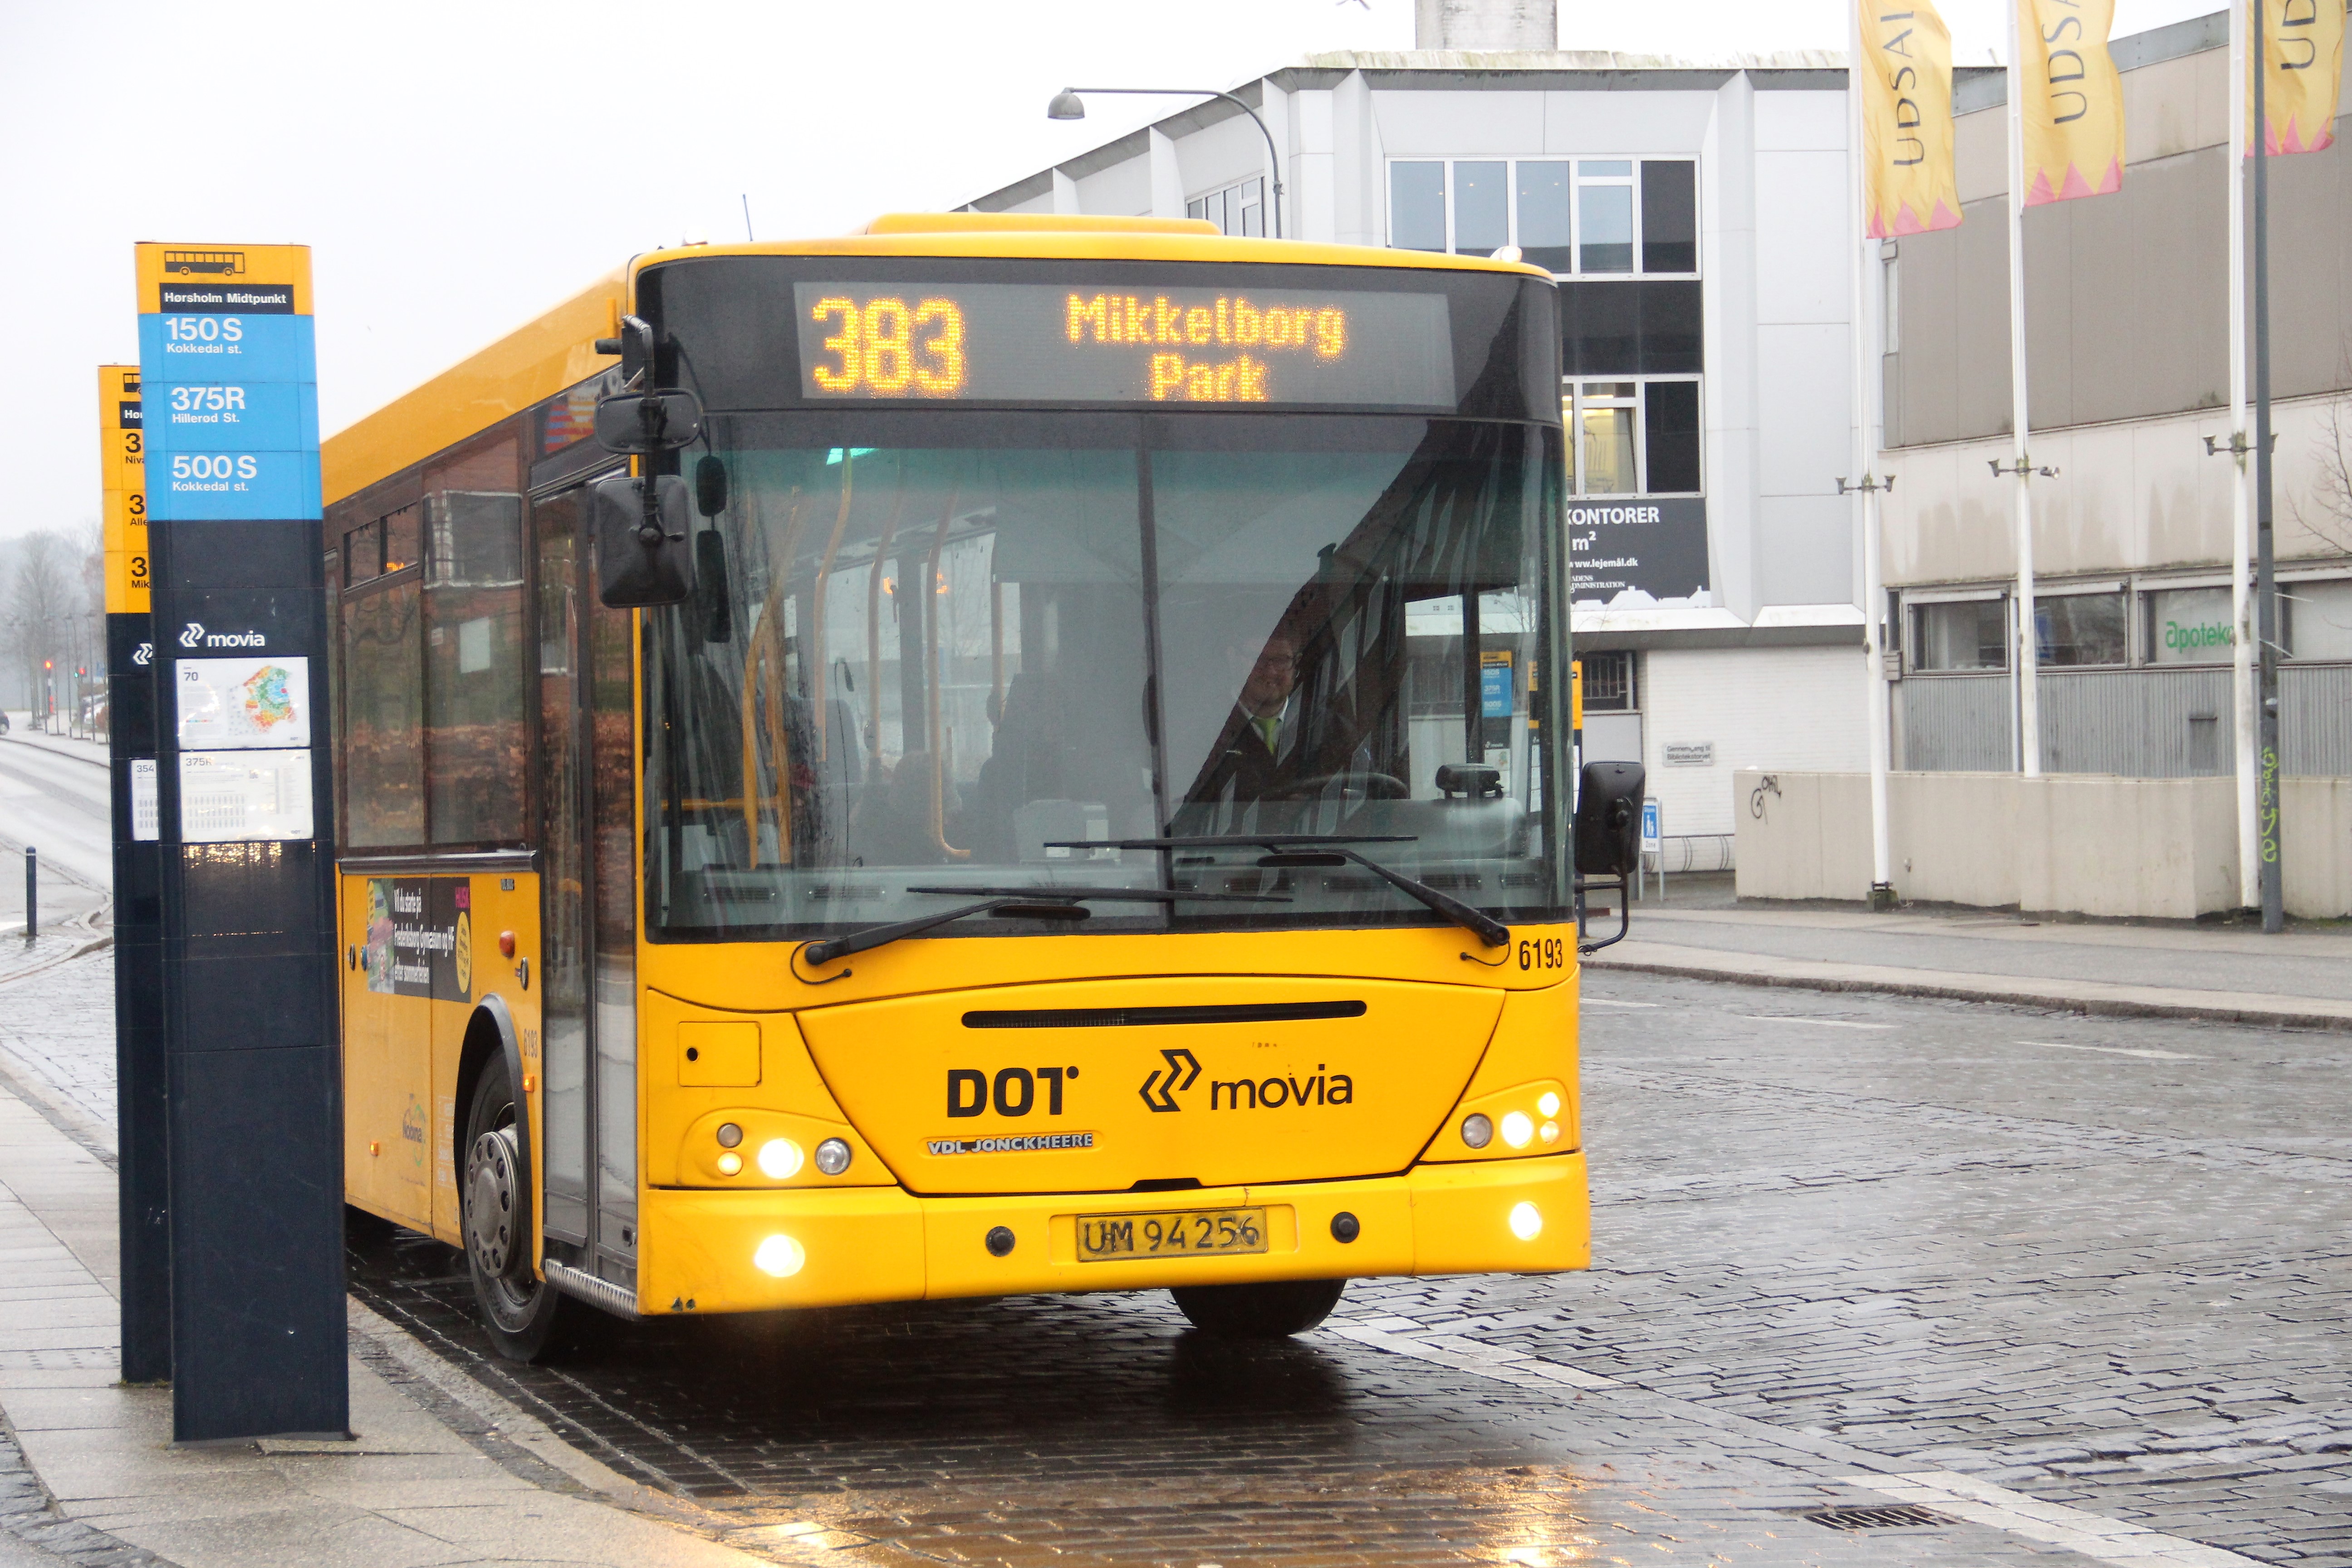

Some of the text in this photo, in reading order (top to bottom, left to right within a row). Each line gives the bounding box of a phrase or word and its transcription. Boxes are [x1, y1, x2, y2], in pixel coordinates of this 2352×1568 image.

[165, 292, 287, 305] Hørsholm Midtpunkt
[167, 343, 242, 354] Kokkedal st.
[813, 294, 1345, 392] 383 Mikkelborg
[1151, 353, 1269, 401] Park
[171, 387, 245, 411] 375R
[172, 412, 240, 423] Hillerød St.
[173, 482, 249, 491] Kokkedal st.
[207, 630, 265, 647] movia
[184, 671, 199, 681] 70
[137, 764, 154, 773] 354
[1519, 939, 1562, 970] 6193
[947, 1063, 1353, 1117] DOT movia
[928, 1133, 1093, 1156] VDL JONCKHEERE
[1084, 1221, 1133, 1254] UM
